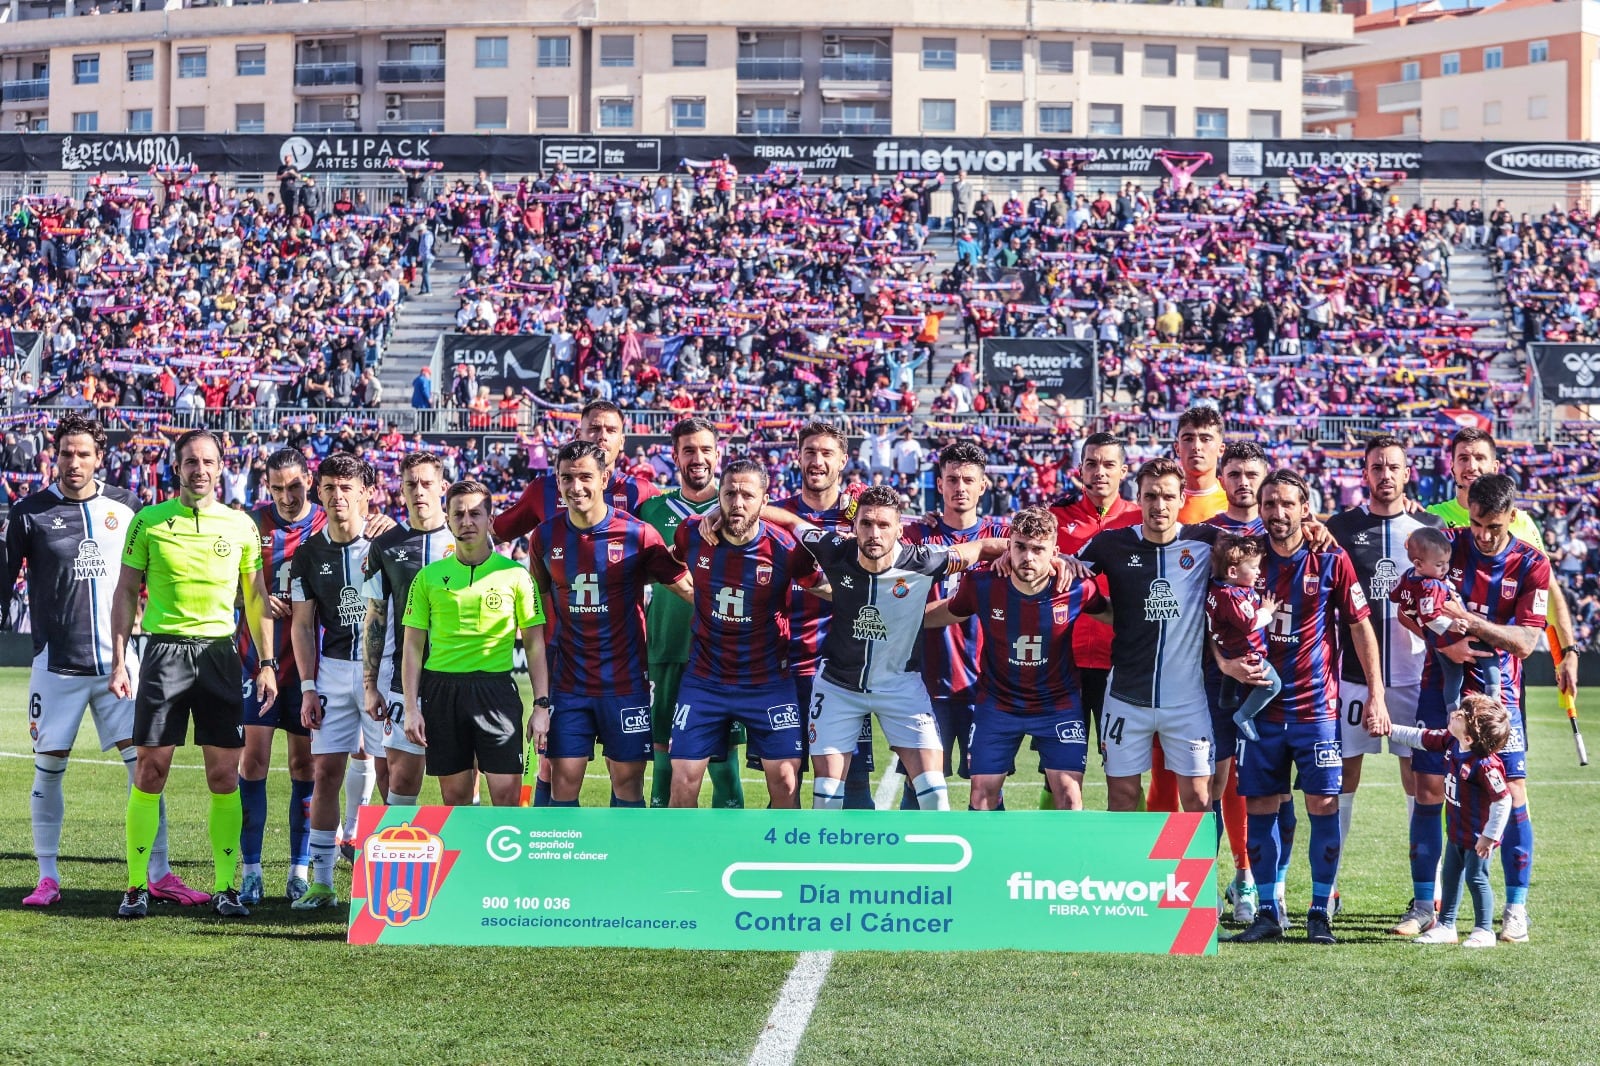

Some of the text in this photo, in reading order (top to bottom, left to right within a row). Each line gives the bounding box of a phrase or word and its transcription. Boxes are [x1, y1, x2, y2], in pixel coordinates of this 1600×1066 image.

[78, 136, 179, 166] DECAMBRO
[316, 139, 430, 156] ALIPACK
[754, 143, 853, 158] FIBRA Y MÓVIL
[1109, 148, 1120, 160] Y
[1122, 146, 1162, 160] MÓV
[316, 158, 358, 168] ARTES
[873, 142, 1046, 172] finetwork
[1265, 152, 1317, 168] MAIL
[1319, 152, 1378, 169] BOXES
[1501, 153, 1600, 169] NOGUERAS
[453, 350, 498, 364] ELDA
[992, 352, 1083, 368] finetwork
[76, 560, 106, 568] RIVIERA
[571, 573, 600, 605] fi
[569, 604, 608, 613] network
[716, 587, 745, 616] fi
[1146, 600, 1179, 608] RIVIERA
[712, 610, 752, 623] network
[855, 621, 887, 631] RIVIERA
[1270, 635, 1300, 643] twork
[1012, 635, 1043, 660] fi
[1008, 657, 1048, 667] network
[625, 713, 650, 728] CRC
[773, 711, 799, 724] CRC
[1103, 713, 1126, 745] 14
[530, 829, 582, 838] asociación
[764, 827, 899, 845] 4 de febrero
[529, 840, 574, 849] española
[528, 851, 608, 860] contra el cáncer
[1006, 872, 1191, 902] finetwork
[799, 884, 952, 905] Día mundial
[482, 896, 571, 909] 900 100 036
[1049, 903, 1148, 916] FIBRA Y MÓVIL
[481, 915, 697, 929] asociacioncontraelcancer.es
[735, 911, 953, 932] Contra el Cáncer
